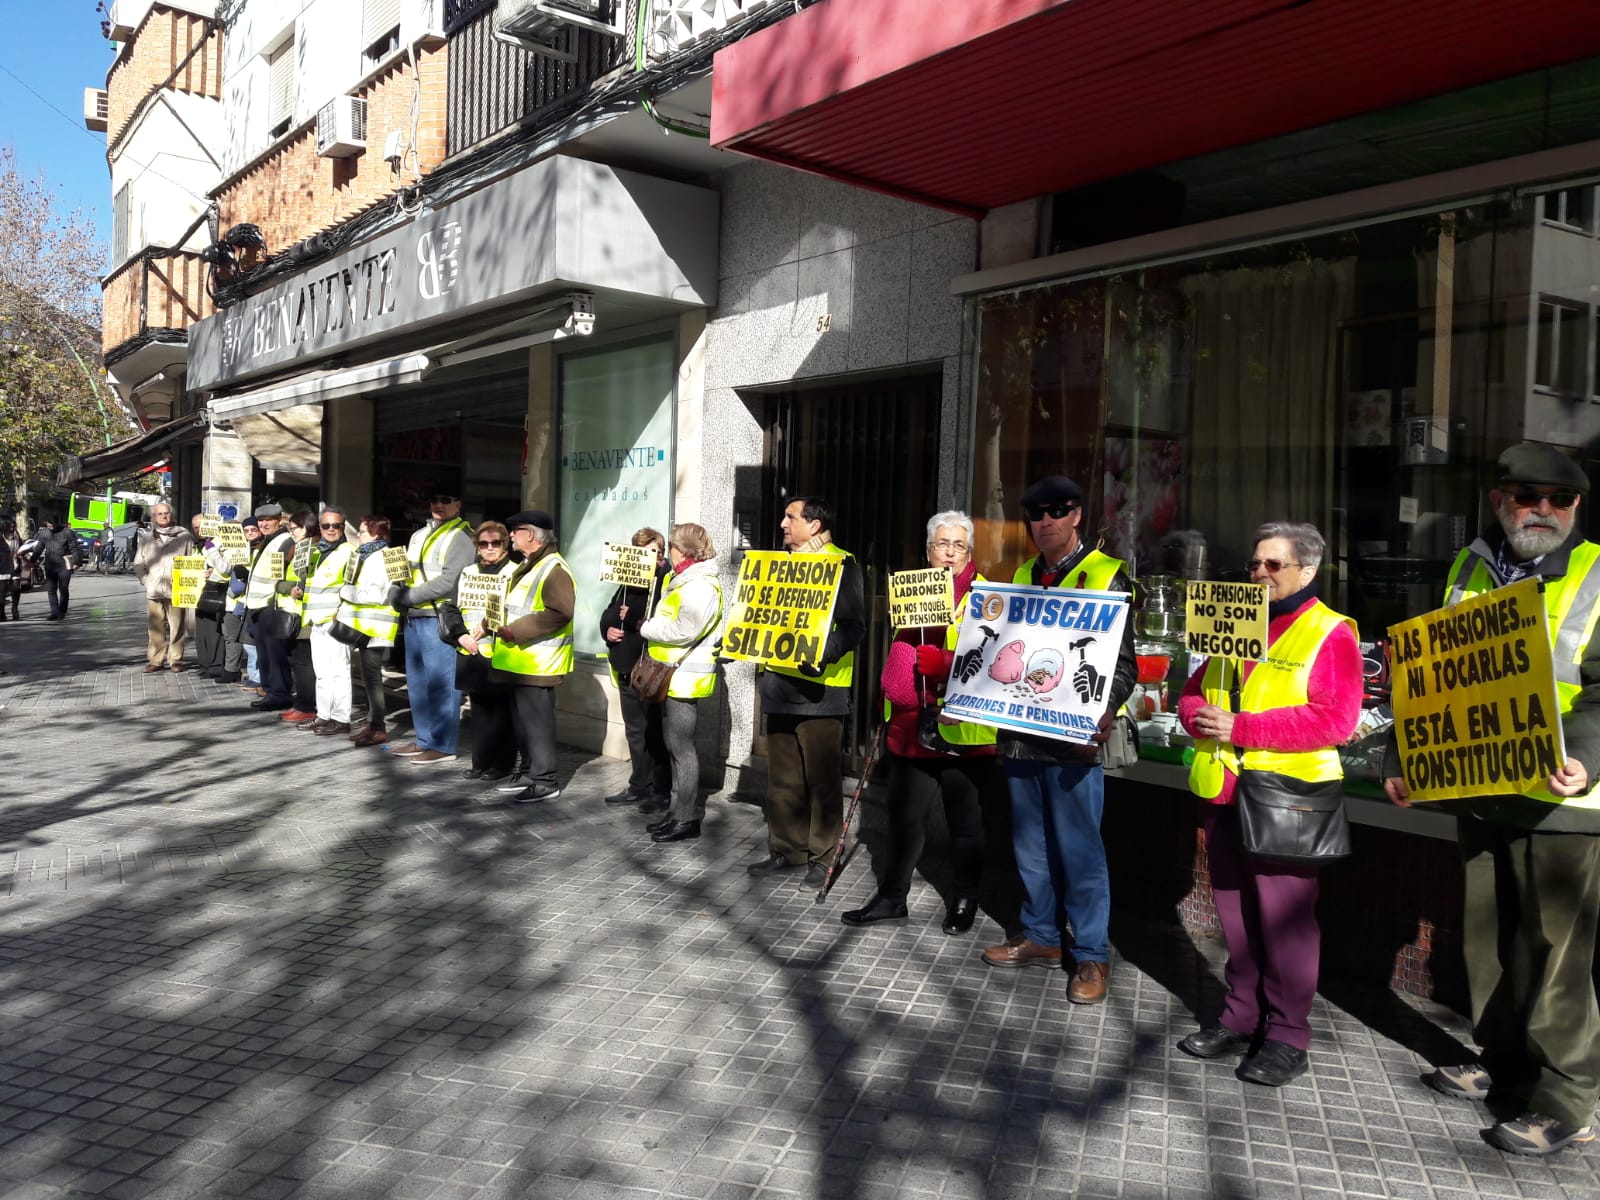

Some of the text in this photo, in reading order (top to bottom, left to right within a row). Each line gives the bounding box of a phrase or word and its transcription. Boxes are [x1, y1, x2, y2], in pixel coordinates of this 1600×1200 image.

[252, 247, 397, 358] BENAVENTE
[816, 314, 831, 332] 54
[569, 447, 655, 471] BENAVENTE
[575, 487, 648, 502] calzados
[610, 545, 649, 557] CAPITAL
[626, 555, 640, 563] SUS
[604, 559, 651, 572] SERVIDORES
[612, 567, 641, 577] CONTRA
[742, 558, 838, 586] LA PENSIÓN
[463, 573, 505, 583] PENSIONES
[464, 582, 501, 591] PRIVADAS
[617, 575, 651, 586] MAYORES
[460, 592, 485, 600] PERSO
[738, 584, 831, 611] NO SE DEFIENDE
[895, 583, 947, 598] LADRONES!
[1190, 585, 1264, 605] LAS PENSIONES
[460, 600, 485, 608] ESTAFA
[892, 604, 902, 615] NO
[904, 602, 917, 614] NOS
[1195, 604, 1257, 621] NO SON
[743, 607, 810, 629] DESDE EL
[892, 612, 952, 626] LAS PENSIONES
[1008, 597, 1121, 633] BUSCAN
[1213, 620, 1235, 634] UN
[1394, 597, 1537, 664] LAS PENSIONES...
[726, 627, 820, 664] SILLÓN
[1189, 632, 1262, 659] NEGOCIO
[1407, 639, 1530, 700] NI TOCARLAS
[947, 693, 1005, 714] LADRONES
[1008, 703, 1025, 718] DE
[1026, 706, 1097, 731] PENSIONES
[1403, 693, 1547, 750] ESTÁ EN LA
